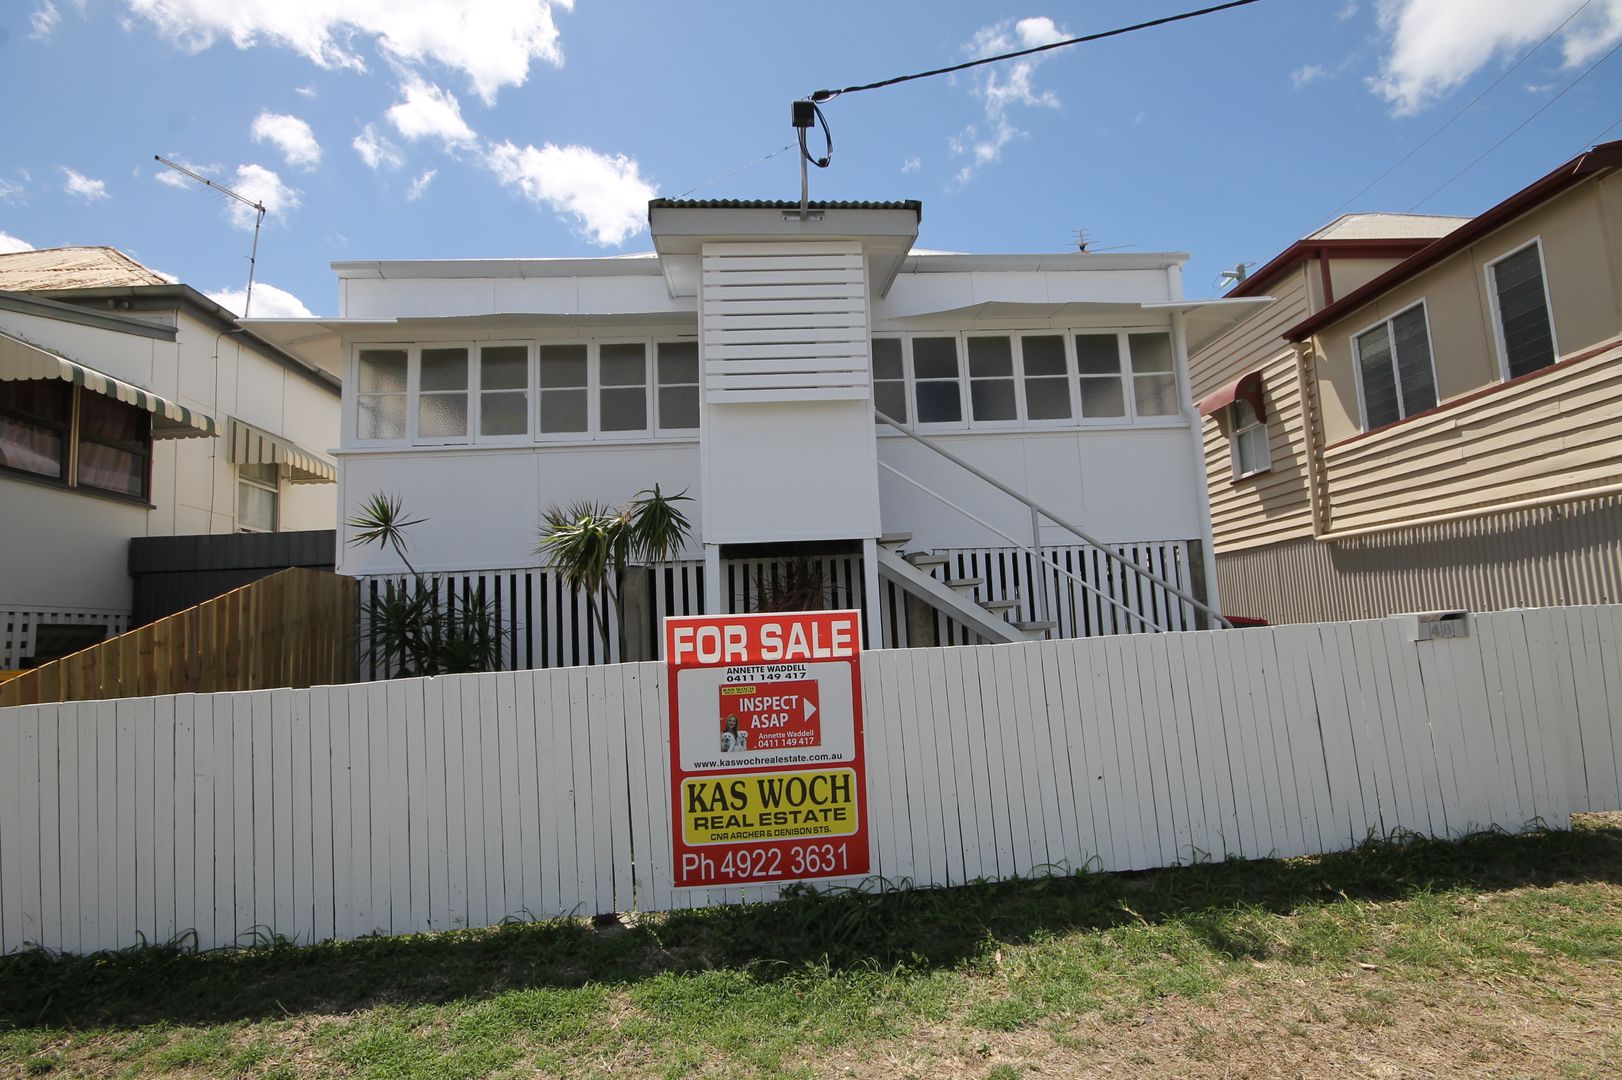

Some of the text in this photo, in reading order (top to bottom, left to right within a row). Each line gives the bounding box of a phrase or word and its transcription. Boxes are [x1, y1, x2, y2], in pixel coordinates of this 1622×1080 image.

[674, 620, 852, 665] FOR SALE
[726, 664, 807, 675] ANNETTE WADDELL
[726, 672, 807, 682] 0411 149 417
[739, 695, 798, 712] INSPECT
[750, 713, 789, 729] ASAP
[758, 730, 814, 740] Annette Waddell
[758, 737, 814, 748] 0411 149 417
[694, 752, 842, 768] www.kaswochrealestate.com.au
[687, 774, 851, 813] KAS WOCH
[694, 808, 847, 831] REAL ESTATE
[710, 826, 832, 841] CNR ARCHER & DENISON STS.
[682, 843, 848, 881] Ph 4922 3631
